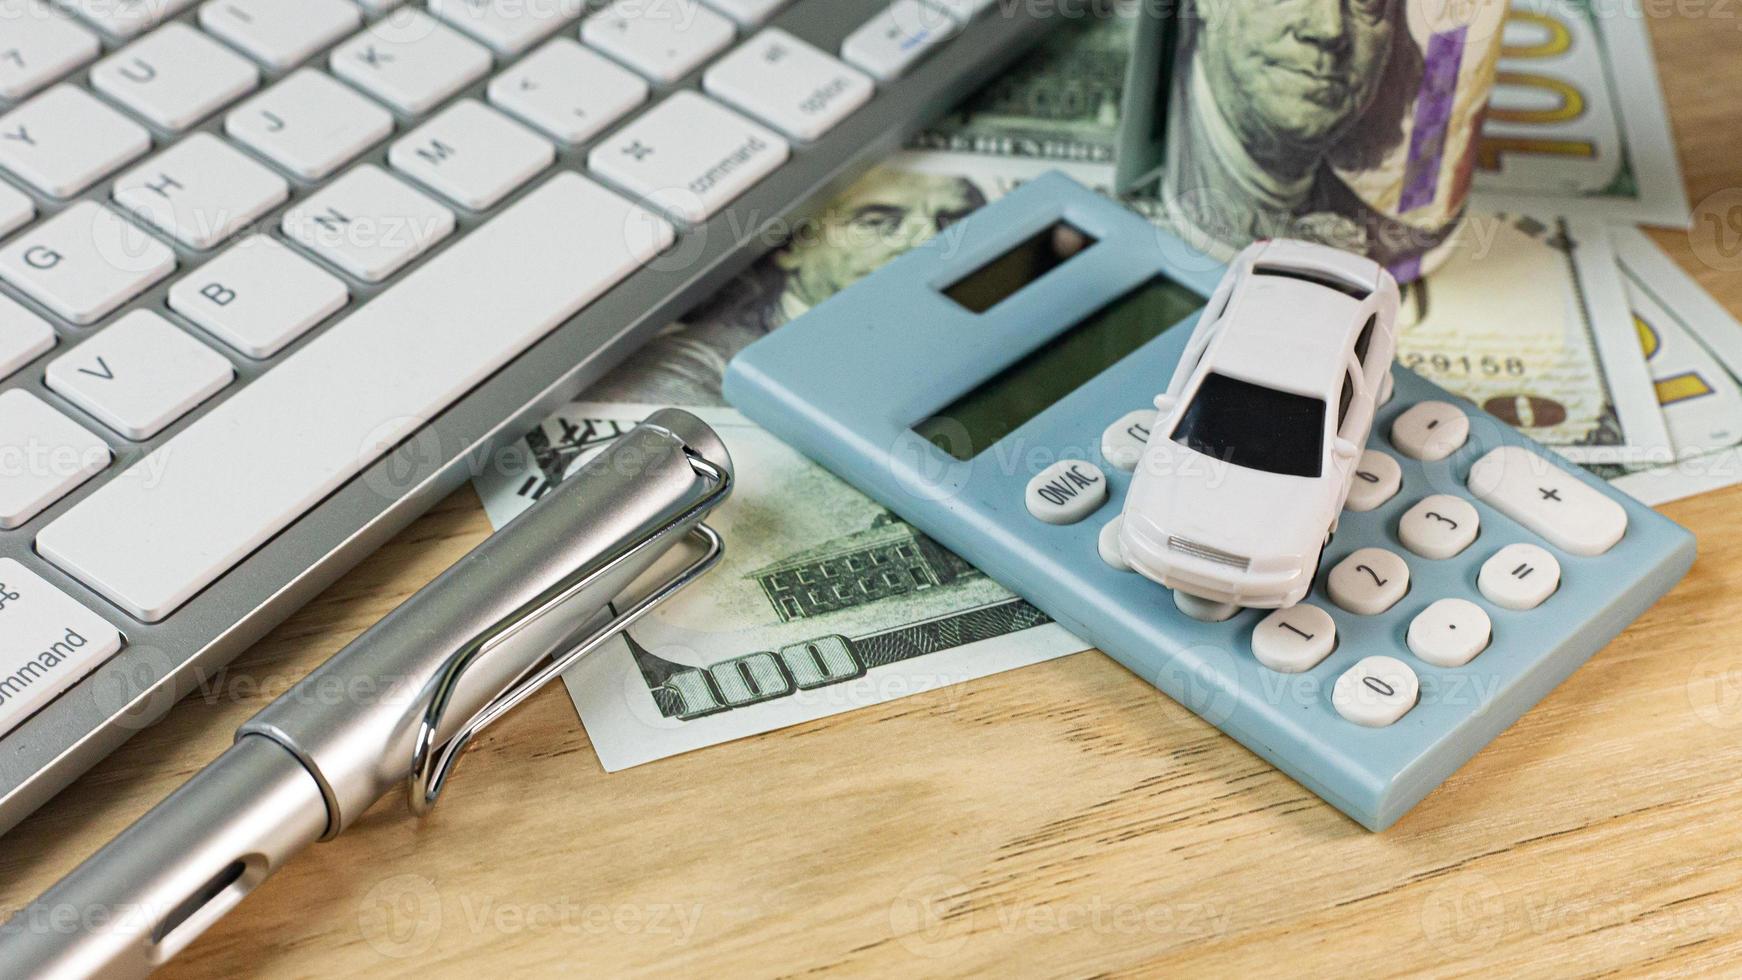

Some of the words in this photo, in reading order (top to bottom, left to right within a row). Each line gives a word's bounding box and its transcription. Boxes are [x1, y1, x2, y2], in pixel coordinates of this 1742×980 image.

[358, 44, 395, 69] K
[119, 59, 156, 82] U
[261, 110, 285, 132] J
[4, 124, 36, 145] Y
[416, 139, 456, 165] M
[689, 136, 767, 194] command
[145, 173, 185, 198] H
[313, 206, 351, 233] N
[23, 244, 64, 271] G
[200, 282, 236, 306] B
[78, 356, 115, 382] V
[1037, 465, 1099, 506] ON/AC
[1425, 511, 1458, 530] 3
[1355, 564, 1389, 587] 2
[1278, 621, 1315, 641] 1
[663, 633, 867, 722] 100
[1362, 675, 1395, 697] 0
